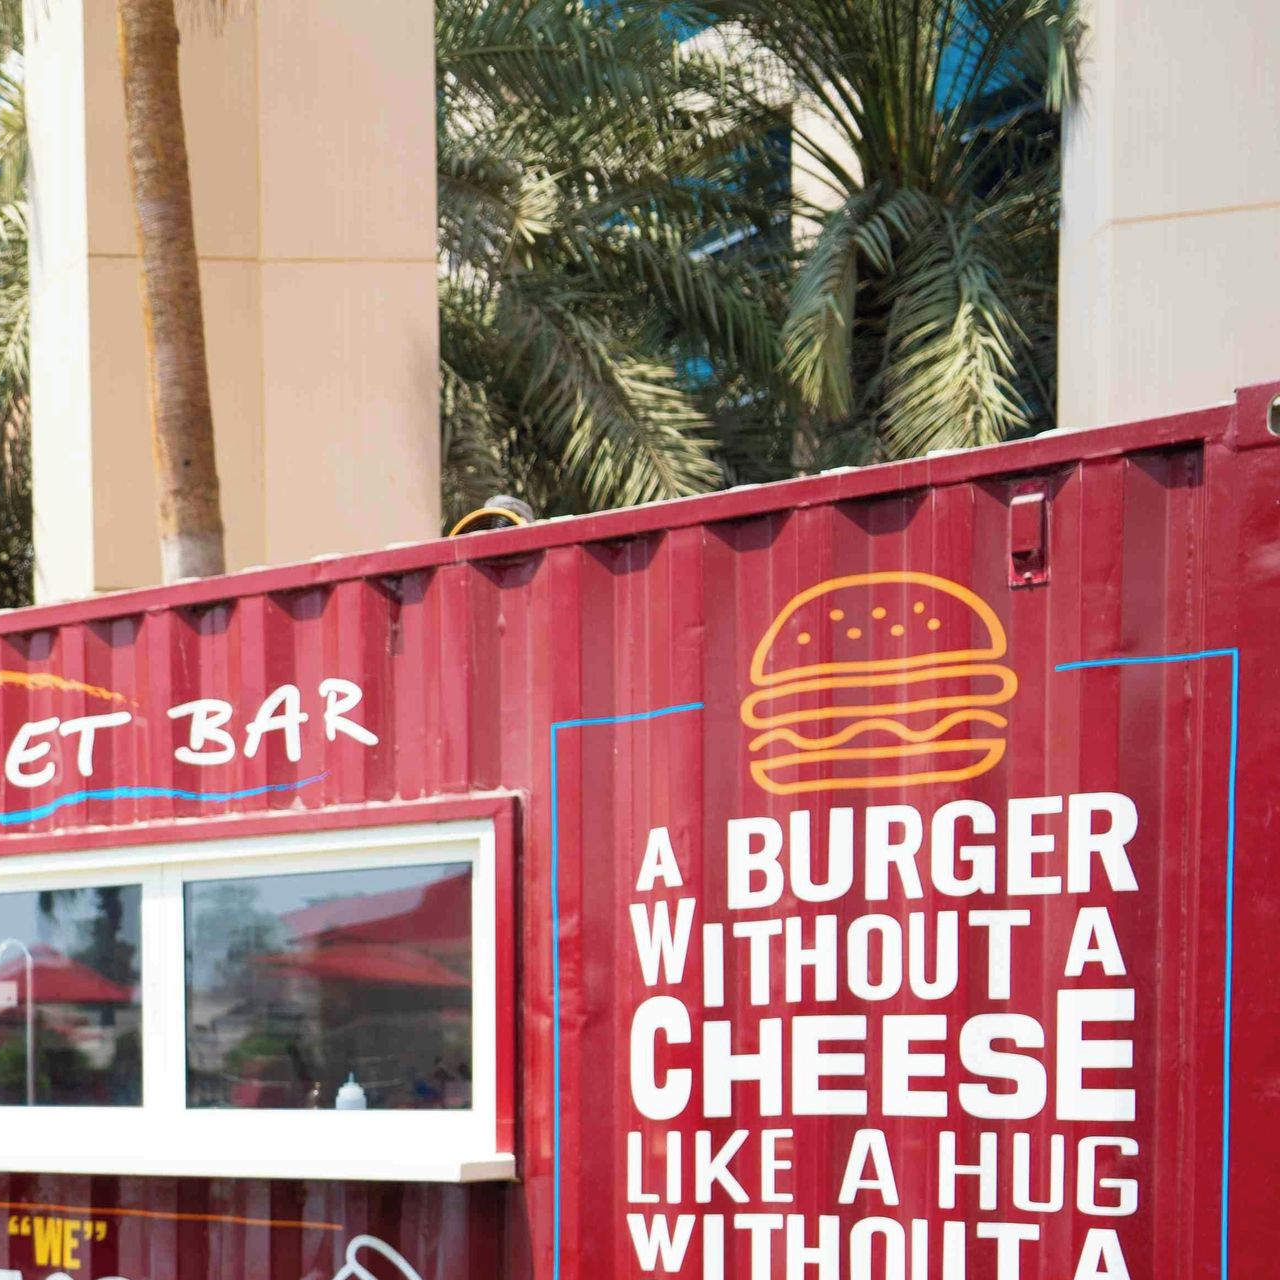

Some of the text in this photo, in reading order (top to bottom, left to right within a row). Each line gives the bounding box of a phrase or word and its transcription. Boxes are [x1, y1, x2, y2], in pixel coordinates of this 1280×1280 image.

[166, 677, 379, 767] BAR
[635, 792, 1139, 910] A BURGER
[629, 897, 1126, 1007] WITHOUT A
[630, 988, 1136, 1122] CHEESE
[627, 1128, 1139, 1216] LIKE A HUG
[8, 1215, 107, 1269] “WE”
